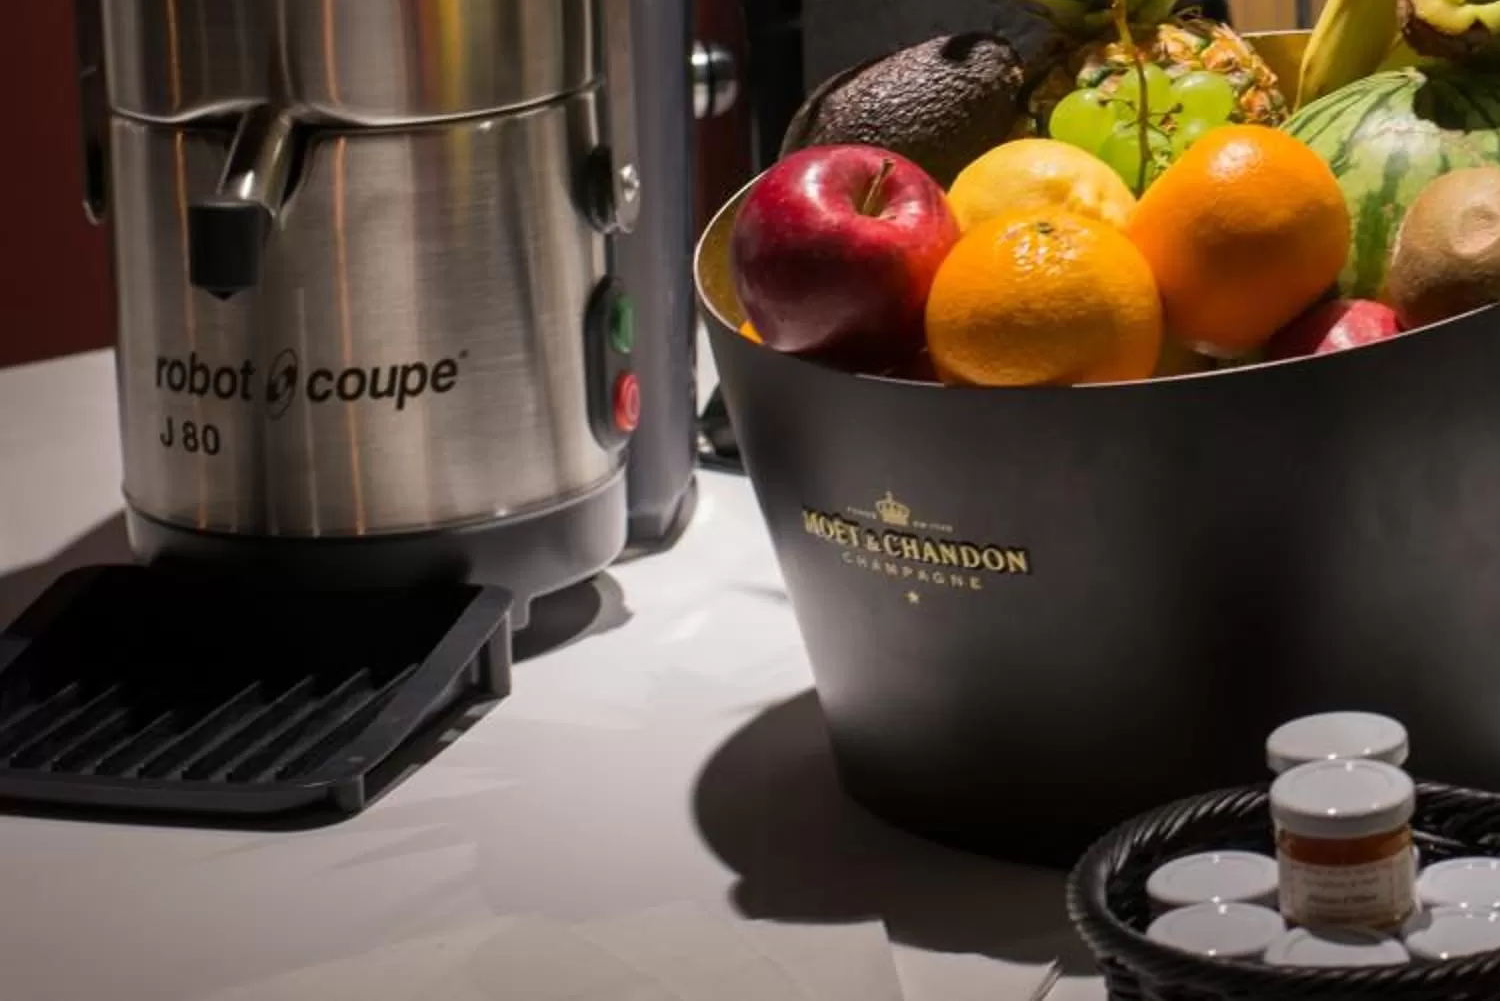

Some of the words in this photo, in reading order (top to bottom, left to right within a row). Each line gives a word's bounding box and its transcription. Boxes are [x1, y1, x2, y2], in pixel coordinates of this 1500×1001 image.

[155, 352, 255, 401] robot
[306, 356, 459, 411] coupe
[842, 551, 983, 591] CHAMPAGNE
[883, 533, 1029, 574] CHANDON
